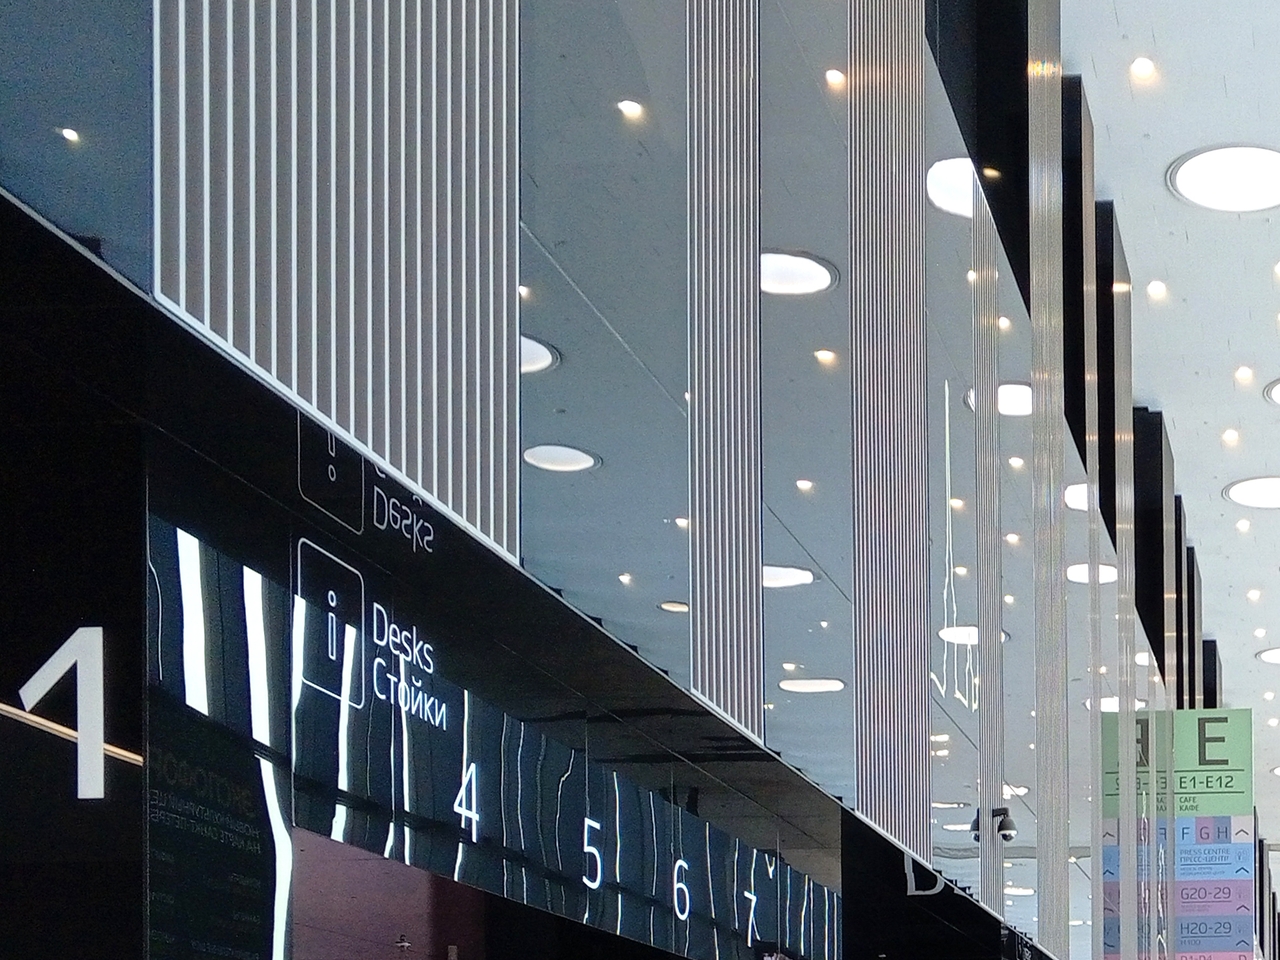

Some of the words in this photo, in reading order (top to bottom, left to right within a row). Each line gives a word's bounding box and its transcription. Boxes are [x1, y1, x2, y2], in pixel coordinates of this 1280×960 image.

[373, 601, 434, 674] Desks
[18, 626, 104, 799] 1
[373, 657, 447, 731] Стойки
[1198, 716, 1229, 766] E
[453, 762, 480, 843] 4
[1179, 775, 1234, 790] E1-E12
[1179, 796, 1197, 804] CAFE
[1179, 804, 1199, 812] КАФЕ
[582, 818, 602, 890] 5
[1181, 827, 1191, 841] F
[1199, 826, 1210, 841] G
[1217, 826, 1228, 840] H
[673, 859, 690, 921] 6
[1180, 887, 1232, 901] G20-29
[743, 890, 757, 948] 7
[1180, 921, 1232, 935] H20-29
